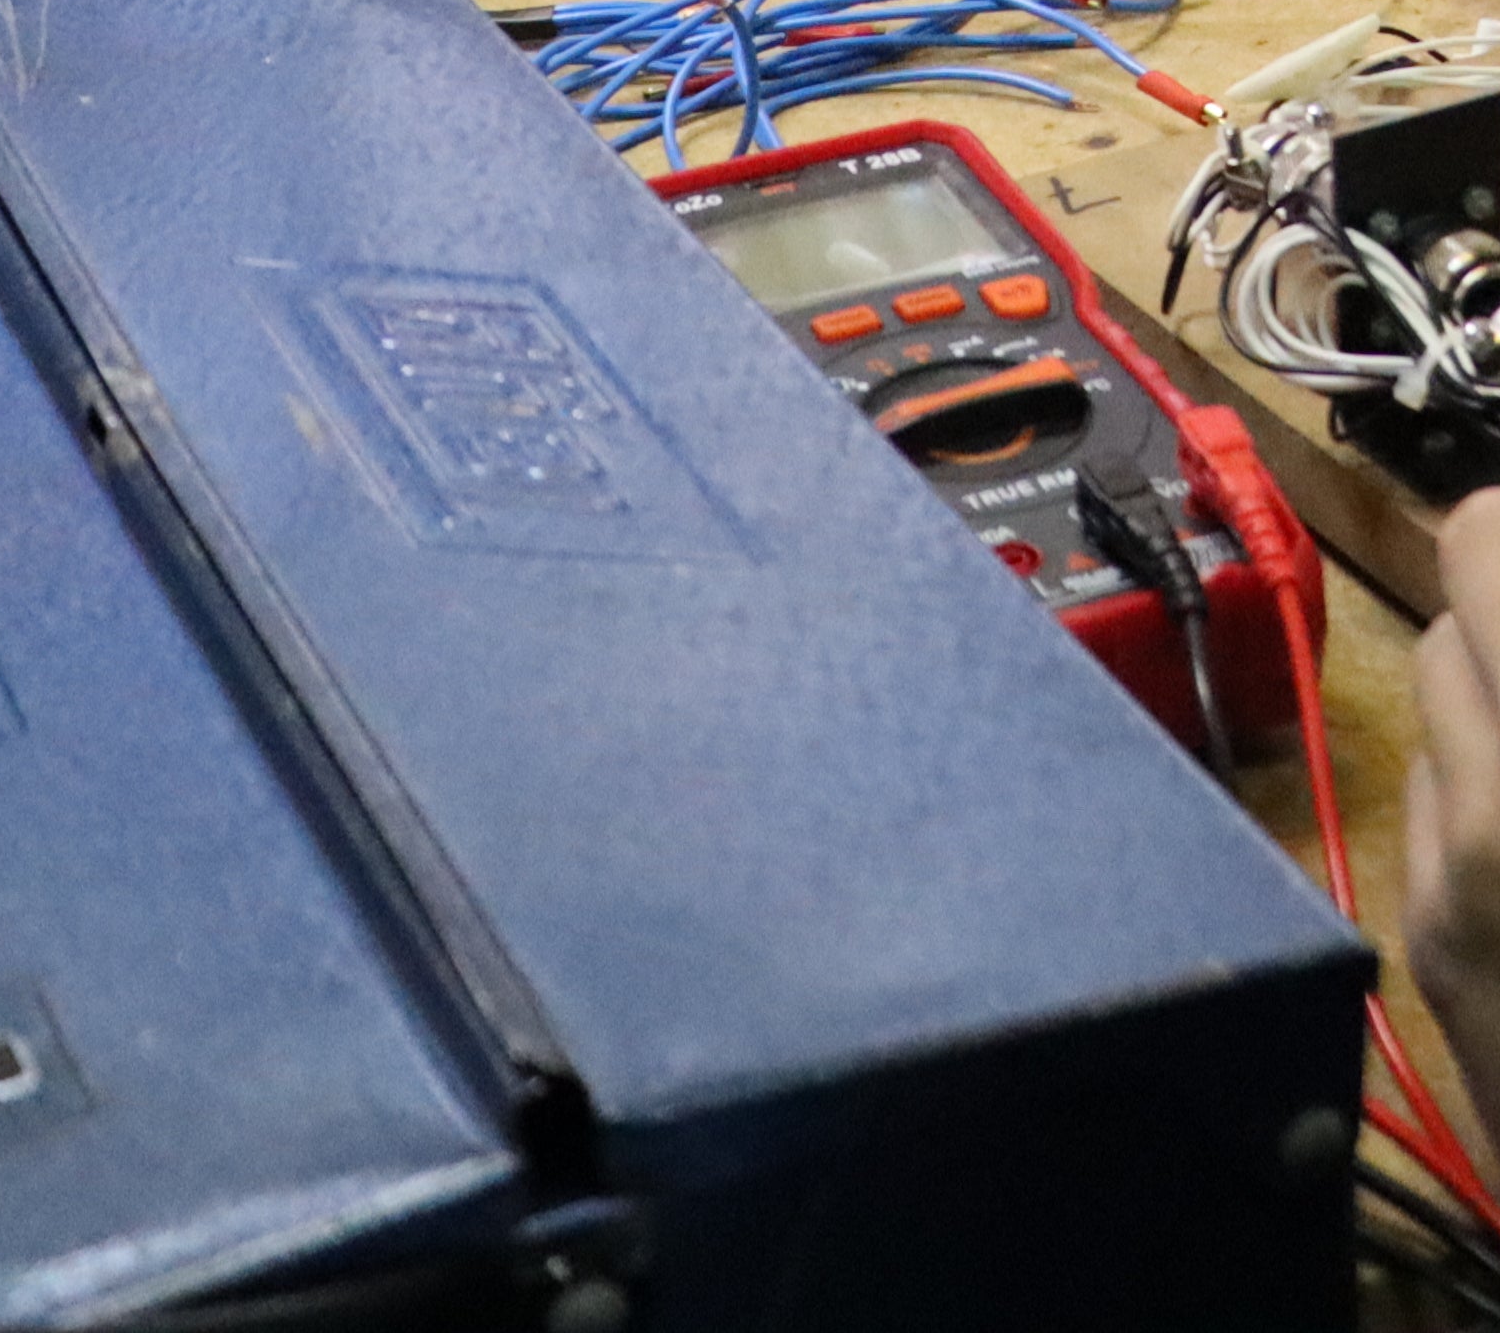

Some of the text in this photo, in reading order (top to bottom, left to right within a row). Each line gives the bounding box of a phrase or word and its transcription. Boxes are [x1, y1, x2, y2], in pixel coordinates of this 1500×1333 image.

[673, 193, 724, 215] oZo
[961, 466, 1079, 511] TRUE RM
